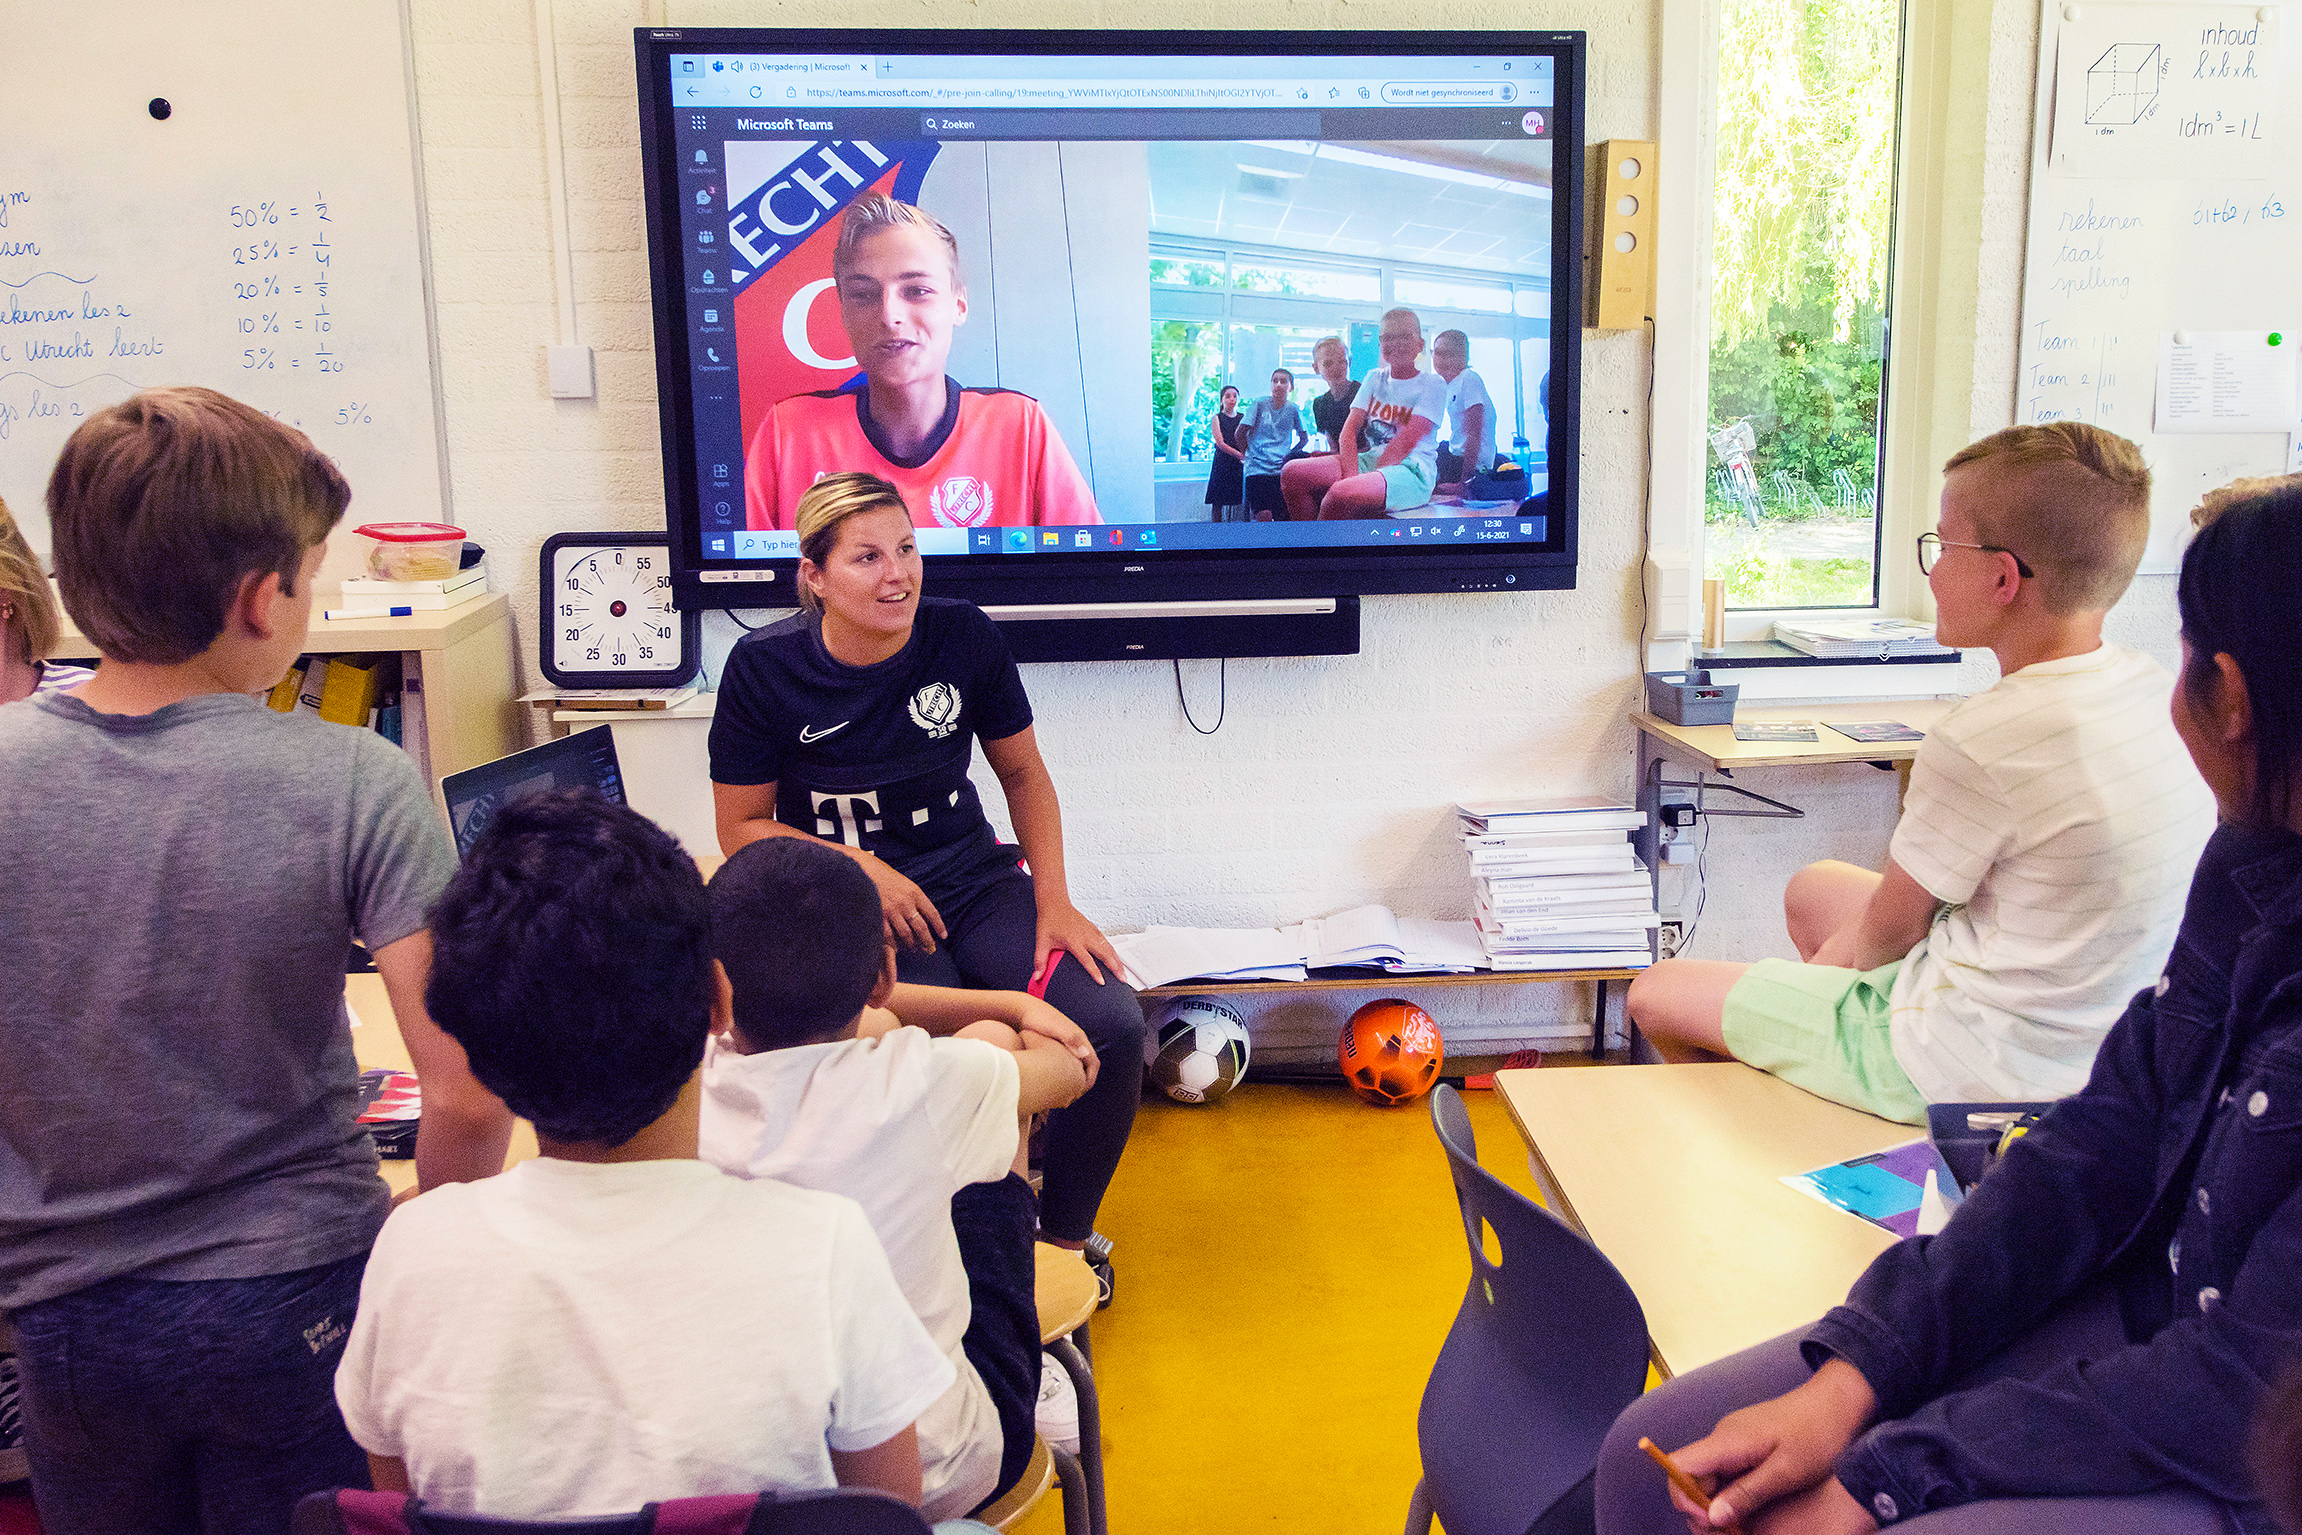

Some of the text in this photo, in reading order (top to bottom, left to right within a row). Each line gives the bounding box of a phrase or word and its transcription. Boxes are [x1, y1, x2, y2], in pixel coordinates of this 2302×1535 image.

[750, 63, 760, 71] (3)
[761, 63, 808, 73] Vergadering
[815, 62, 851, 71] Microsoft
[1391, 88, 1494, 98] Wordt niet gesynchroniseerd
[737, 118, 834, 130] Microsoft Teams
[942, 119, 975, 129] Zoeken
[231, 201, 278, 228] 50%
[2058, 197, 2145, 232] rekenen
[233, 240, 278, 265] 25%
[2052, 236, 2105, 267] taal
[234, 275, 280, 300] 20%
[2050, 266, 2130, 300] spelling
[83, 291, 110, 320] les
[116, 304, 131, 318] 2
[2034, 319, 2079, 351] Team
[26, 331, 94, 361] Utrecht
[243, 347, 275, 370] 5%
[2030, 362, 2090, 389] Team 2
[28, 389, 60, 418] les
[2029, 395, 2083, 423] Team 3
[334, 402, 372, 426] 5%
[952, 483, 958, 494] F
[965, 501, 974, 512] C
[1484, 520, 1502, 528] 12:30
[1476, 531, 1509, 539] 15-6-2021
[762, 540, 798, 552] Typ hier
[615, 553, 622, 565] 0
[637, 558, 651, 569] 55
[590, 560, 597, 571] 5
[566, 579, 579, 590] 10
[657, 576, 671, 588] 50
[559, 605, 573, 616] 15
[566, 629, 579, 641] 20
[657, 627, 671, 639] 40
[586, 648, 600, 660] 25
[639, 647, 653, 659] 35
[612, 654, 626, 666] 30
[1183, 1001, 1243, 1030] DERBYSTAR
